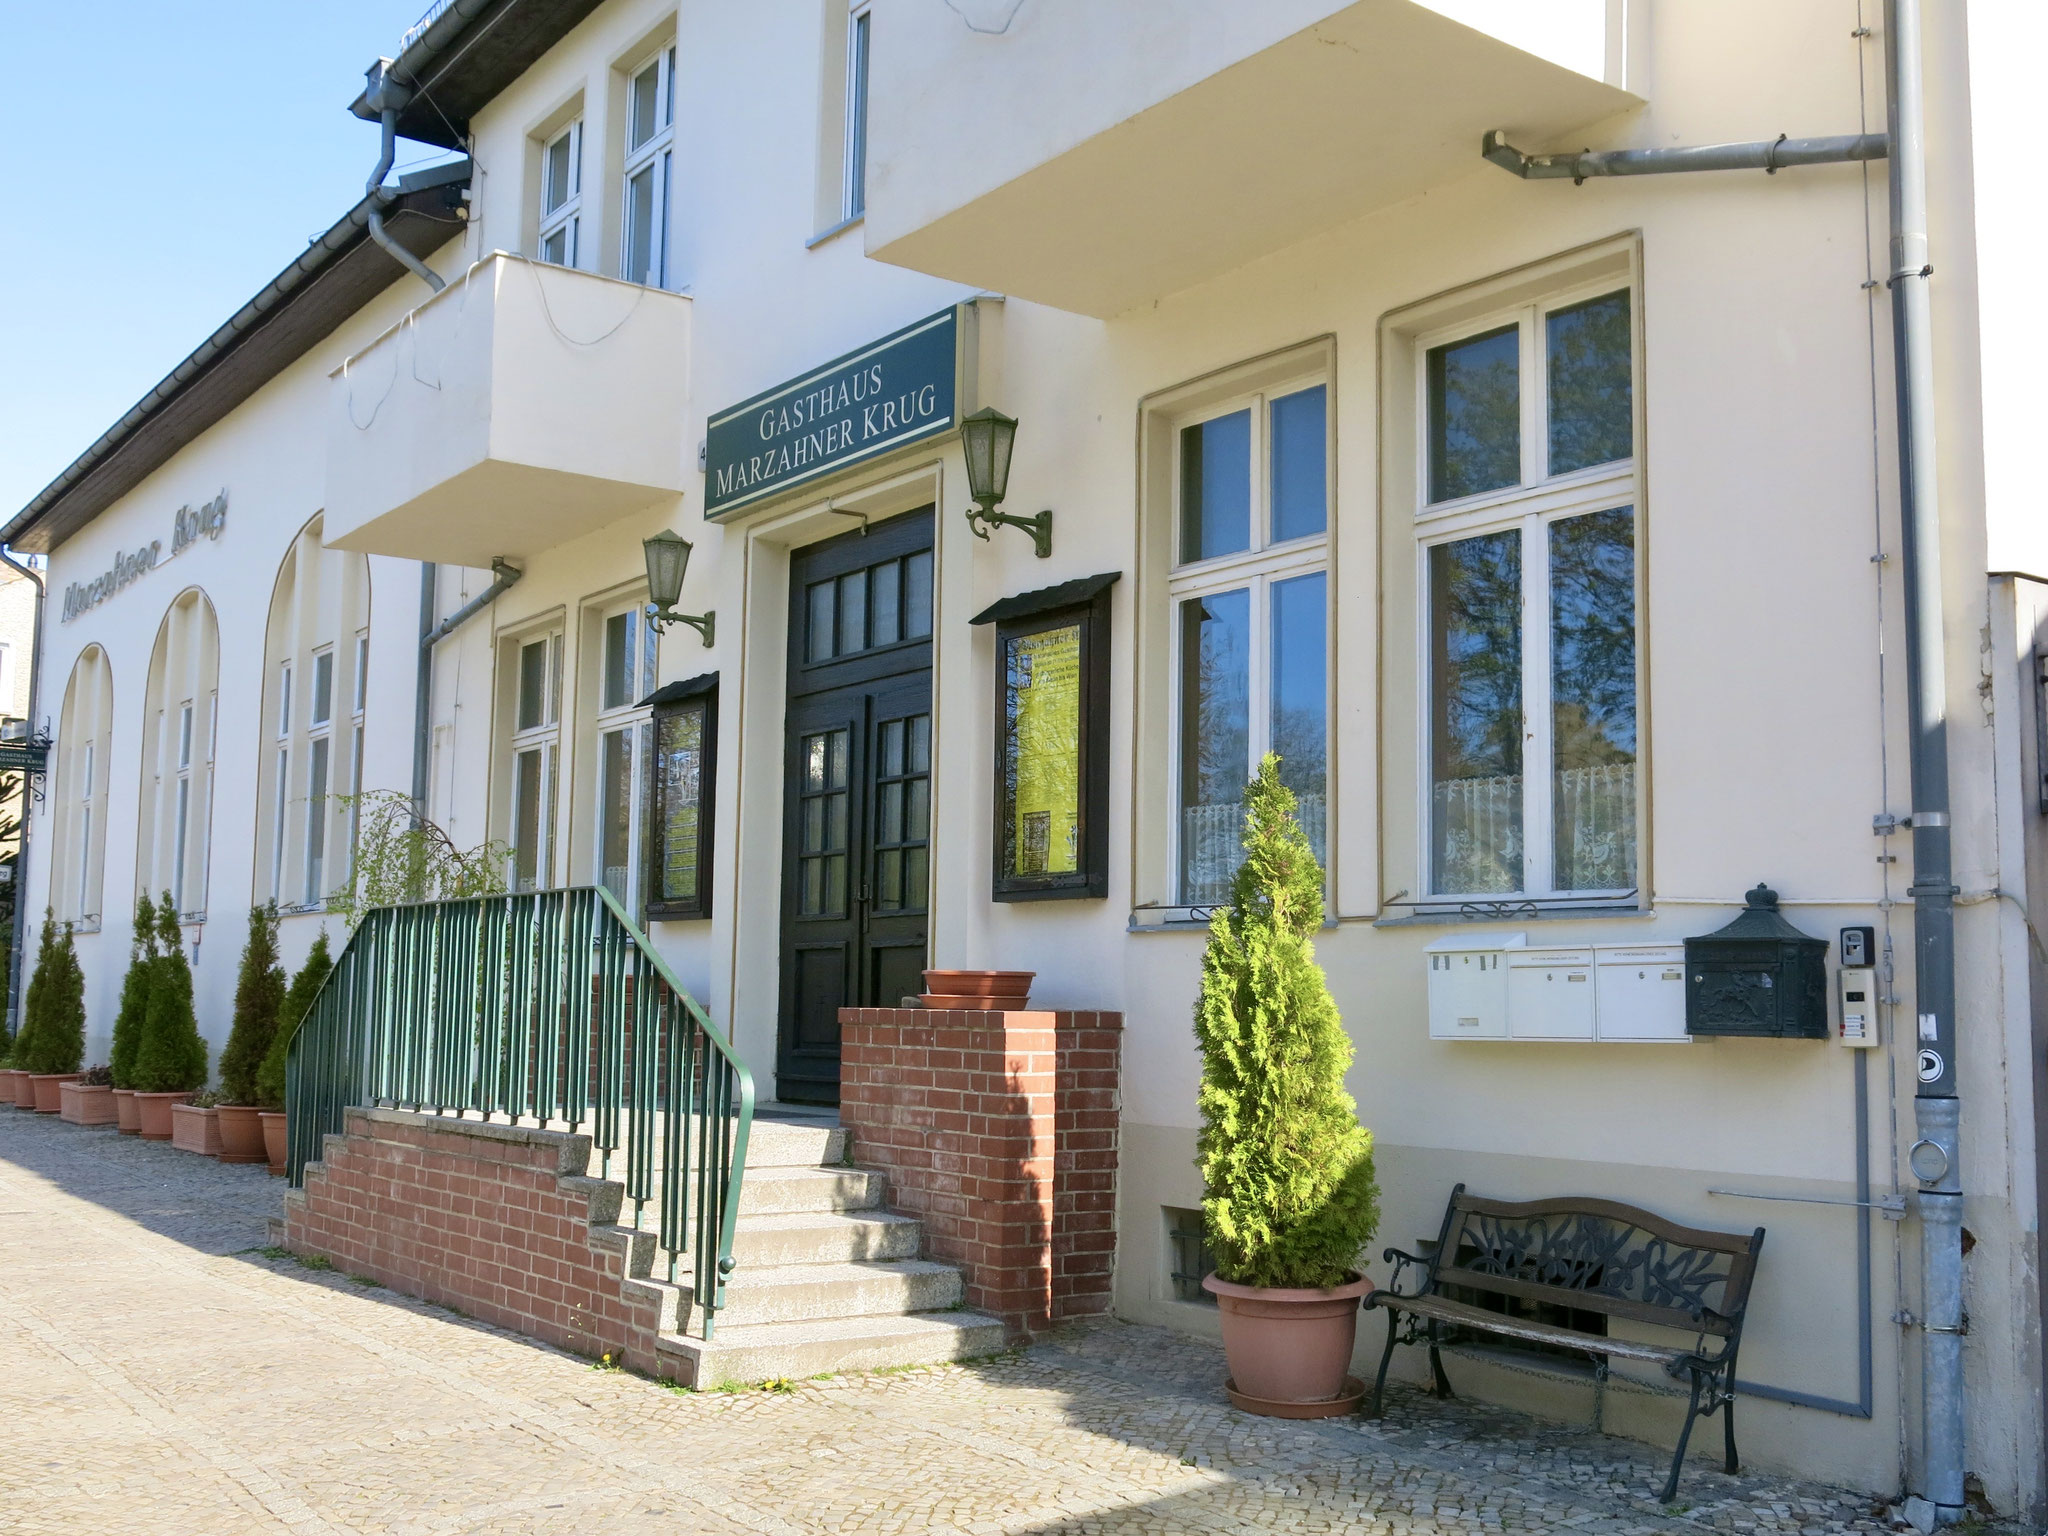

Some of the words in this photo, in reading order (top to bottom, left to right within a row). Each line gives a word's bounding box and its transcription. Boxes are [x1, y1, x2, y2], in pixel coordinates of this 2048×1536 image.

[715, 417, 855, 498] MARZAHNER
[862, 383, 936, 441] KRUG
[759, 363, 883, 441] GASTHAUS
[61, 540, 162, 623] Marzahner
[171, 487, 229, 555] Krug
